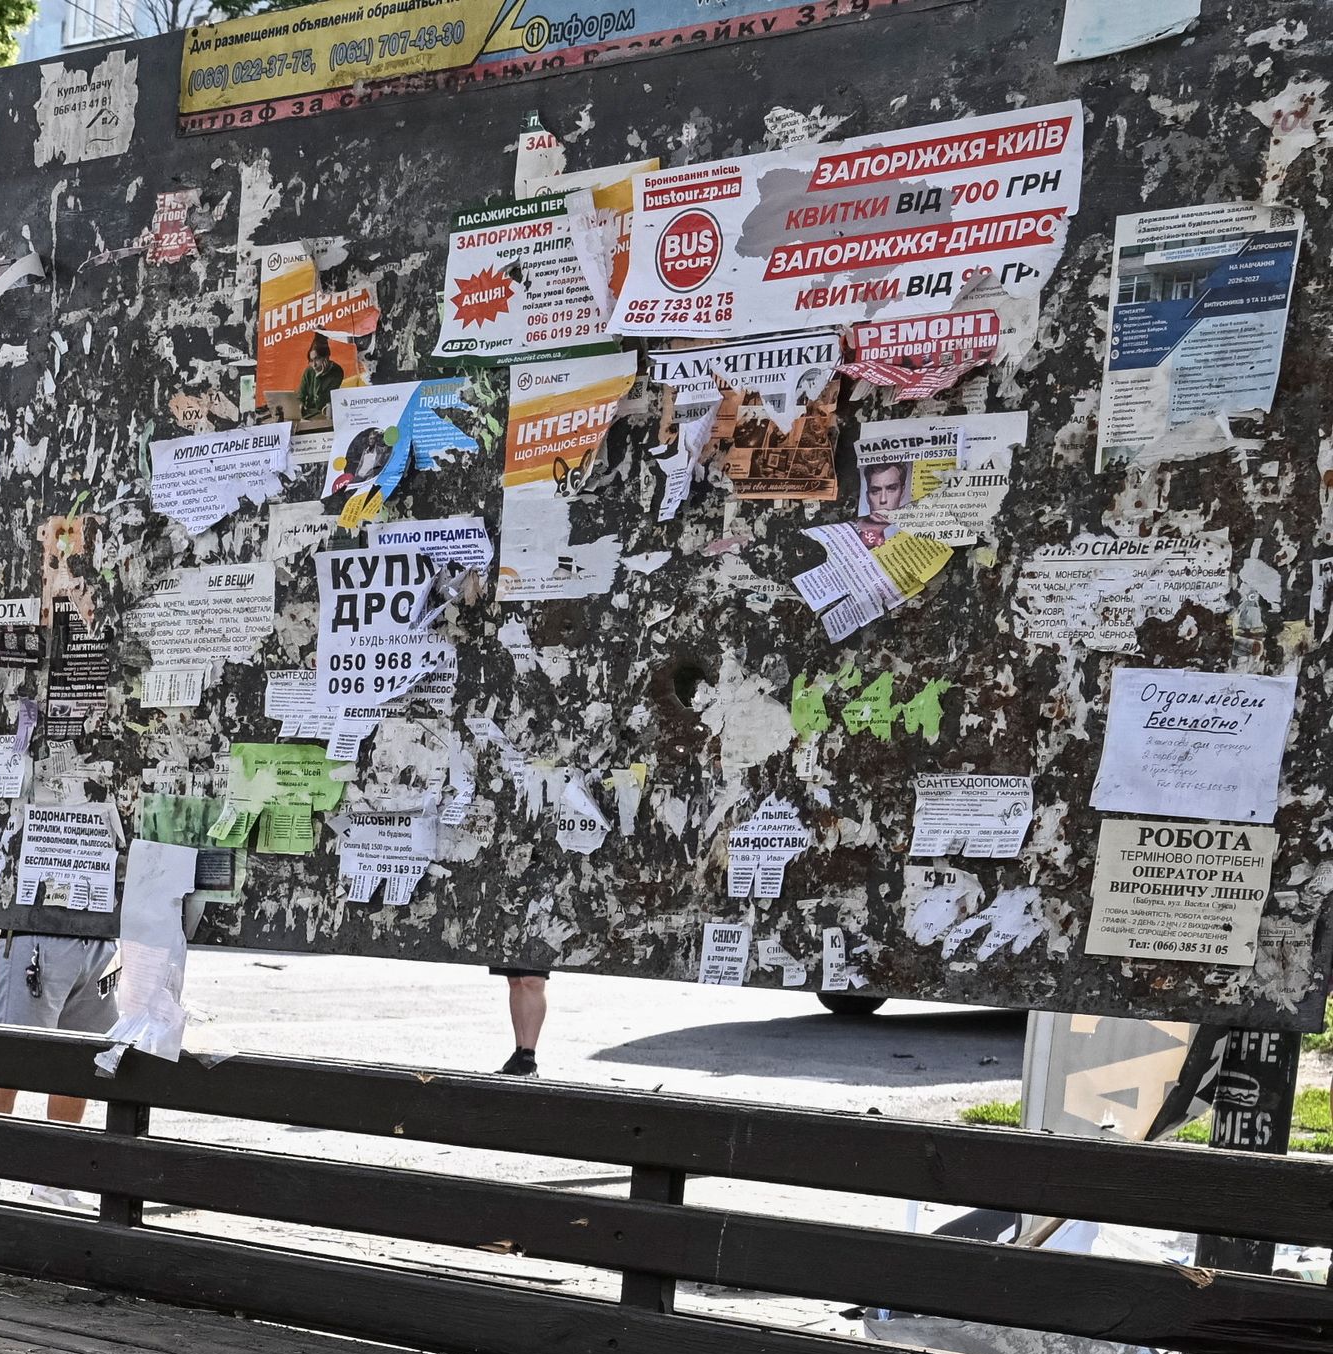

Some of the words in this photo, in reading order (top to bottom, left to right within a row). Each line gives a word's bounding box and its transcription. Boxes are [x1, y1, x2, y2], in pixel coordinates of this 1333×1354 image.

[189, 37, 212, 55] Для
[214, 24, 290, 50] размещения
[291, 10, 365, 36] объявлений
[188, 65, 230, 96] (066)
[232, 49, 317, 84] 022-37-75,
[329, 41, 374, 72] (061)
[379, 20, 466, 57] 707-43-30
[56, 83, 89, 98] Куплю
[90, 78, 113, 94] дачу
[53, 102, 71, 117] 066
[71, 100, 87, 114] 413
[88, 98, 100, 112] 41
[100, 96, 113, 109] 81
[293, 93, 325, 117] за
[814, 121, 1065, 186] ЗАПОРІЖЖЯ-КИЇВ
[644, 168, 710, 188] Бронювання
[711, 164, 741, 180] місць
[645, 181, 741, 209] bustour.zp.ua
[784, 195, 890, 231] КВИТКИ
[895, 187, 943, 215] ВІД
[951, 179, 1000, 206] 700
[1006, 169, 1063, 199] ГРН
[458, 204, 539, 227] ПАСАЖИРСЬКІ
[456, 221, 553, 250] ЗАПОРІЖЖЯ
[664, 229, 715, 260] BUS
[770, 213, 1056, 274] ЗАПОРІЖЖЯ-ДНІПРО
[496, 245, 531, 261] через
[533, 237, 575, 255] ДНІПР
[282, 254, 309, 265] DIANET
[522, 258, 558, 271] Даруємо
[664, 256, 714, 272] TOUR
[535, 267, 560, 279] кожну
[461, 287, 506, 307] АКЦІЯ!
[526, 290, 542, 302] При
[543, 287, 565, 300] умові
[794, 278, 901, 312] КВИТКИ
[906, 271, 953, 299] ВІД
[522, 299, 553, 312] поїздки
[554, 298, 564, 308] за
[627, 299, 660, 312] 067
[663, 297, 693, 312] 733
[696, 295, 713, 310] 02
[717, 292, 734, 307] 75
[527, 313, 549, 327] 096
[551, 309, 575, 324] 019
[576, 306, 592, 321] 29
[624, 312, 656, 324] 050
[660, 312, 689, 324] 746
[692, 310, 711, 324] 41
[715, 308, 733, 322] 68
[263, 333, 284, 348] ЩО
[284, 314, 334, 341] ЗАВЖДИ
[526, 328, 548, 343] 066
[551, 325, 575, 340] 019
[575, 322, 592, 336] 29
[594, 320, 608, 335] 19
[857, 312, 997, 348] РЕМОНТ
[479, 337, 514, 350] Турист
[861, 339, 938, 361] ПОБУТОВОЇ
[940, 334, 998, 353] ТЕХНІКИ
[535, 372, 571, 386] DIANET
[516, 400, 619, 446] ІНТЕРНЕ
[173, 445, 210, 461] КУПЛЮ
[211, 439, 251, 455] СТАРЫЕ
[252, 434, 281, 450] ВЕЩИ
[514, 449, 533, 462] ЩО
[533, 437, 578, 458] ПРАЦЮЄ
[579, 432, 598, 446] БЕЗ
[378, 530, 422, 546] КУПЛЮ
[424, 527, 486, 541] ПРЕДМЕТЫ
[225, 574, 255, 588] ВЕЩИ
[331, 553, 437, 590] КУПЛ
[331, 590, 417, 634] ДРО
[349, 637, 358, 647] У
[359, 634, 424, 648] БУДЬ-ЯКОМУ
[329, 653, 367, 672] 050
[374, 652, 413, 671] 968
[328, 676, 365, 695] 096
[1141, 683, 1203, 712] Отдам
[1205, 690, 1266, 708] мебель
[917, 777, 1029, 790] САНТЕХДОПОМОГА
[28, 824, 62, 836] СТИРАЛКИ,
[558, 818, 575, 832] 80
[579, 818, 597, 832] 99
[27, 835, 80, 847] МИКРОВОЛНОВКИ,
[1136, 827, 1254, 851] РОБОТА
[25, 855, 72, 868] БЕСПЛАТНАЯ
[73, 860, 111, 872] ДОСТАВКА
[358, 862, 374, 872] Тел.
[376, 863, 392, 874] 093
[411, 865, 422, 875] 13
[1120, 850, 1193, 865] ТЕРМІНОВО
[1196, 853, 1265, 868] ПОТРІБЕН!
[1132, 865, 1218, 883] ОПЕРАТОР
[1222, 870, 1245, 884] НА
[1108, 881, 1209, 899] ВИРОБНИЧУ
[1210, 887, 1265, 902] ЛІНІЮ
[1102, 917, 1127, 926] ГРАФІК
[1137, 919, 1157, 928] ДЕНЬ
[1166, 921, 1179, 929] НІЧ
[1104, 908, 1129, 916] ПОВНА
[1173, 912, 1202, 921] РОБОТА
[712, 929, 743, 945] СНИМУ
[1137, 928, 1177, 938] СПРОЩЕНЕ
[1177, 930, 1229, 942] ОФОРМЛЕННЯ
[1128, 938, 1151, 951] Тел:
[1152, 939, 1178, 954] (066)
[1179, 942, 1198, 953] 385
[1199, 943, 1213, 954] 31
[1215, 944, 1229, 956] 05
